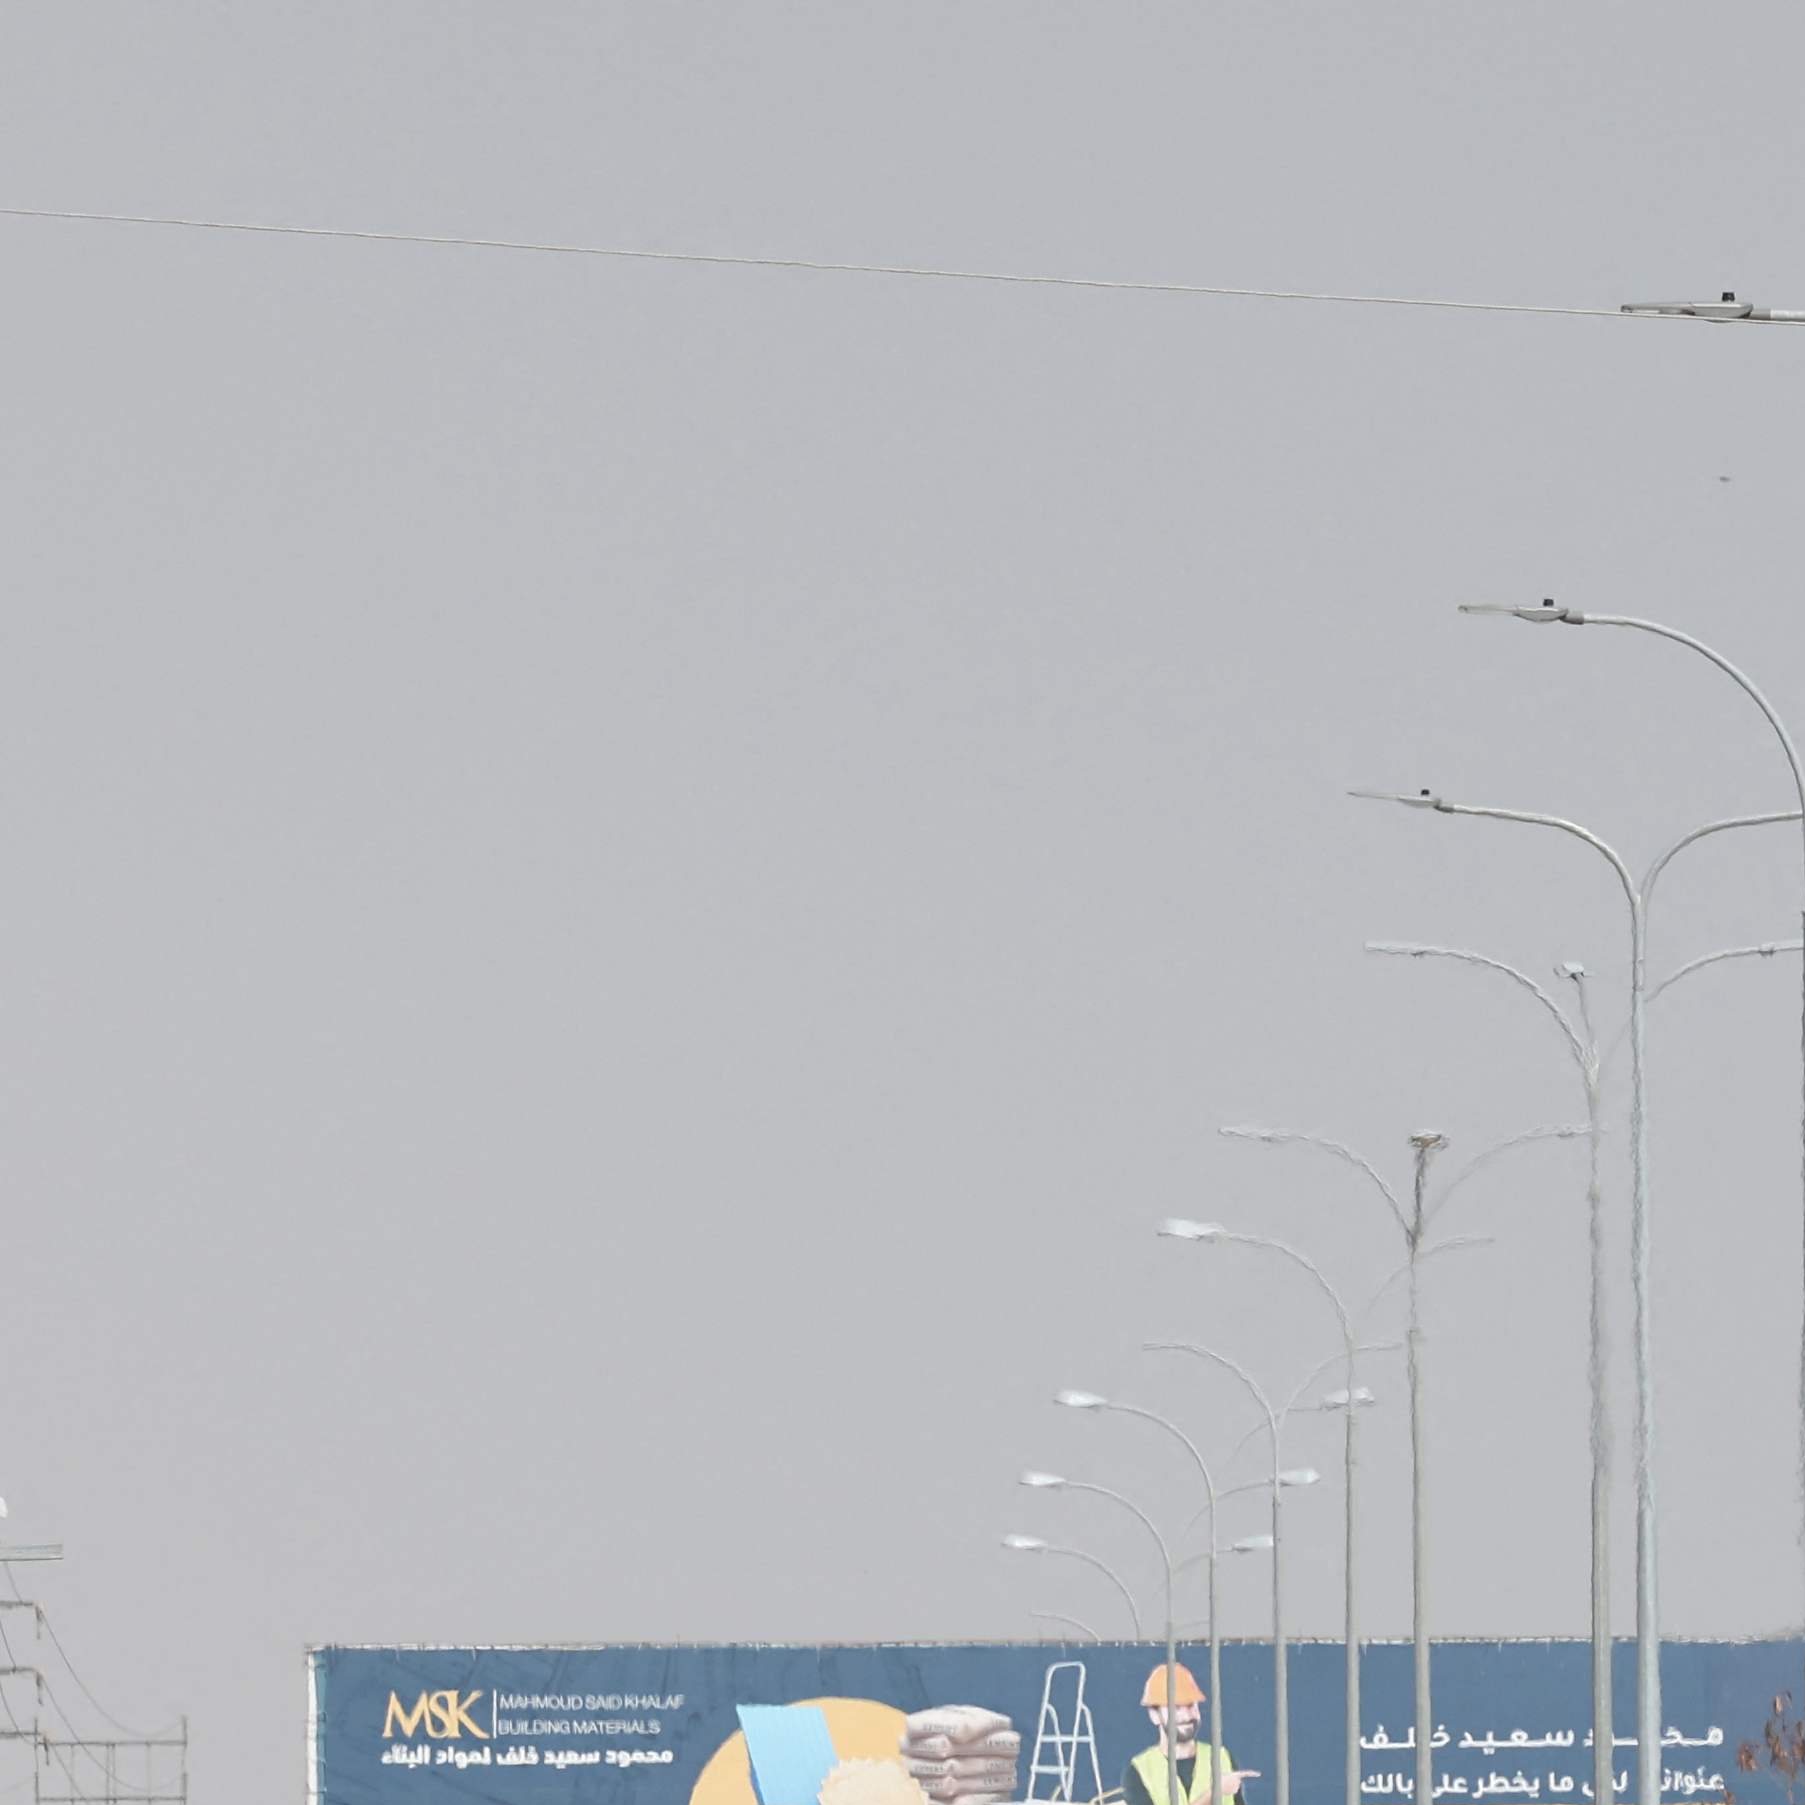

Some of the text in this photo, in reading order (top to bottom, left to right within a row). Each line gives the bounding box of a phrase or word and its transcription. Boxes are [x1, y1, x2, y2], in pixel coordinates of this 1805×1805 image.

[500, 1693, 685, 1711] MAHMOUD SAID KHALAF
[382, 1689, 490, 1739] MSK
[498, 1719, 661, 1736] BUILDING MATERIALS
[1457, 1725, 1575, 1755] سعيد
[435, 1746, 492, 1769] لمواد
[497, 1745, 538, 1766] خلف
[544, 1748, 600, 1769] سعيد
[604, 1747, 674, 1768] محمود
[1473, 1771, 1540, 1799] يخطر
